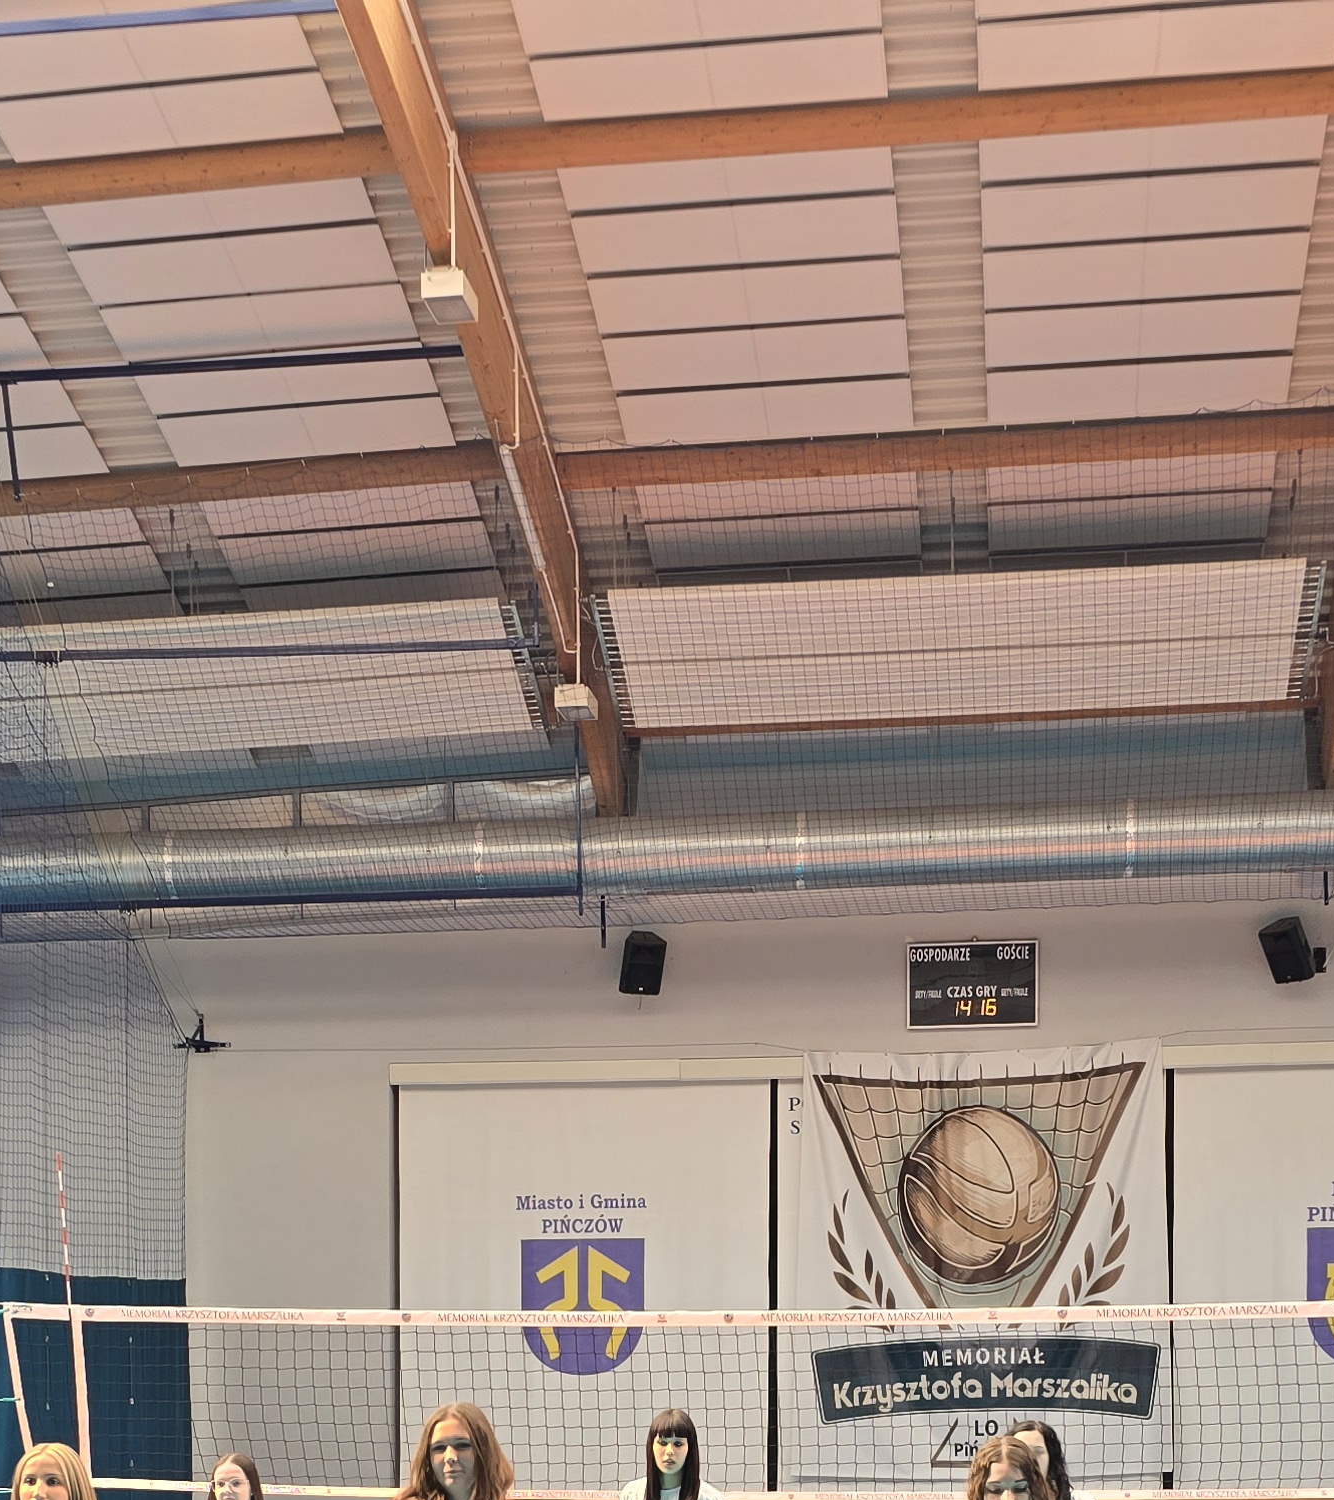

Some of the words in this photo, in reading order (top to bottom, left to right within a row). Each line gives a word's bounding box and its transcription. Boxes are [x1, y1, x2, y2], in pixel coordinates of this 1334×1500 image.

[910, 948, 971, 962] GOSPODARZE
[997, 943, 1030, 960] GOŚCIE
[946, 985, 973, 998] CZAS
[976, 985, 998, 998] GRY
[516, 1195, 573, 1210] Miasto
[579, 1194, 585, 1209] i
[591, 1193, 647, 1209] Gmina
[542, 1214, 624, 1233] PIŃCZÓW
[175, 1309, 238, 1320] KRZYSZTOFA
[493, 1313, 558, 1323] KRZYSZTOFA
[560, 1313, 625, 1323] MARSZALIKA
[818, 1312, 885, 1322] KRZYSZTOFA
[887, 1312, 953, 1322] MARSZALIKA
[1156, 1306, 1226, 1317] KRZYSZTOFA
[1228, 1304, 1299, 1315] MARSZALIKA
[922, 1347, 1046, 1367] MEMORIAŁ
[832, 1371, 983, 1412] Krzysztofa
[990, 1371, 1138, 1405] Marszalika
[974, 1420, 999, 1437] LO
